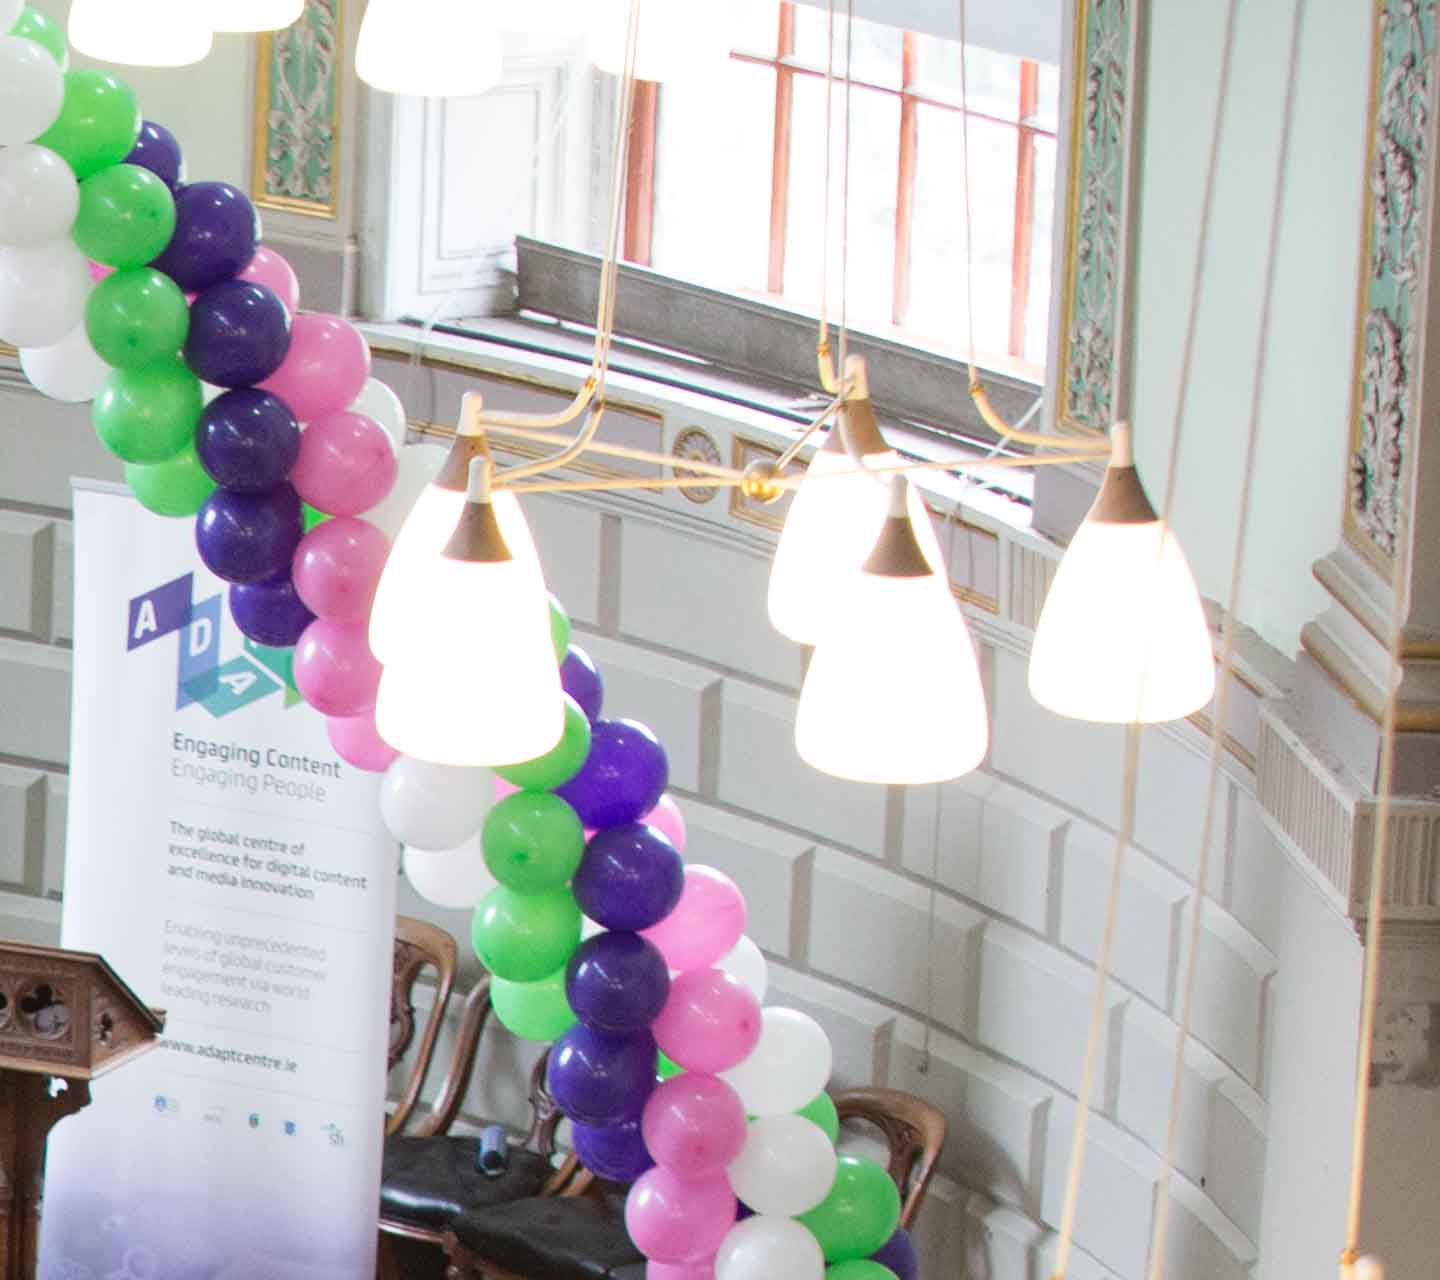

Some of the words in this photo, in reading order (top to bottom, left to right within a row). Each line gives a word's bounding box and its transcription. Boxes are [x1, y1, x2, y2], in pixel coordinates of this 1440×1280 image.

[173, 731, 261, 768] Engaging
[266, 748, 343, 779] Content
[171, 758, 260, 795] Engaging
[263, 773, 327, 802] People
[170, 820, 194, 837] The
[197, 826, 240, 846] global
[242, 834, 287, 853] centre
[290, 843, 306, 856] of
[167, 864, 192, 878] and
[195, 868, 238, 887] media
[240, 876, 315, 900] innovation
[168, 843, 240, 867] excellence
[242, 853, 264, 870] for
[266, 857, 311, 880] digital
[313, 868, 368, 890] content
[164, 920, 222, 946] Enabling
[163, 941, 200, 961] levels
[203, 948, 218, 962] of
[219, 951, 262, 971] global
[162, 963, 247, 988] engagement
[161, 982, 210, 1007] leading
[211, 992, 271, 1014] research
[159, 1037, 298, 1073] www.adaptcentre.ie
